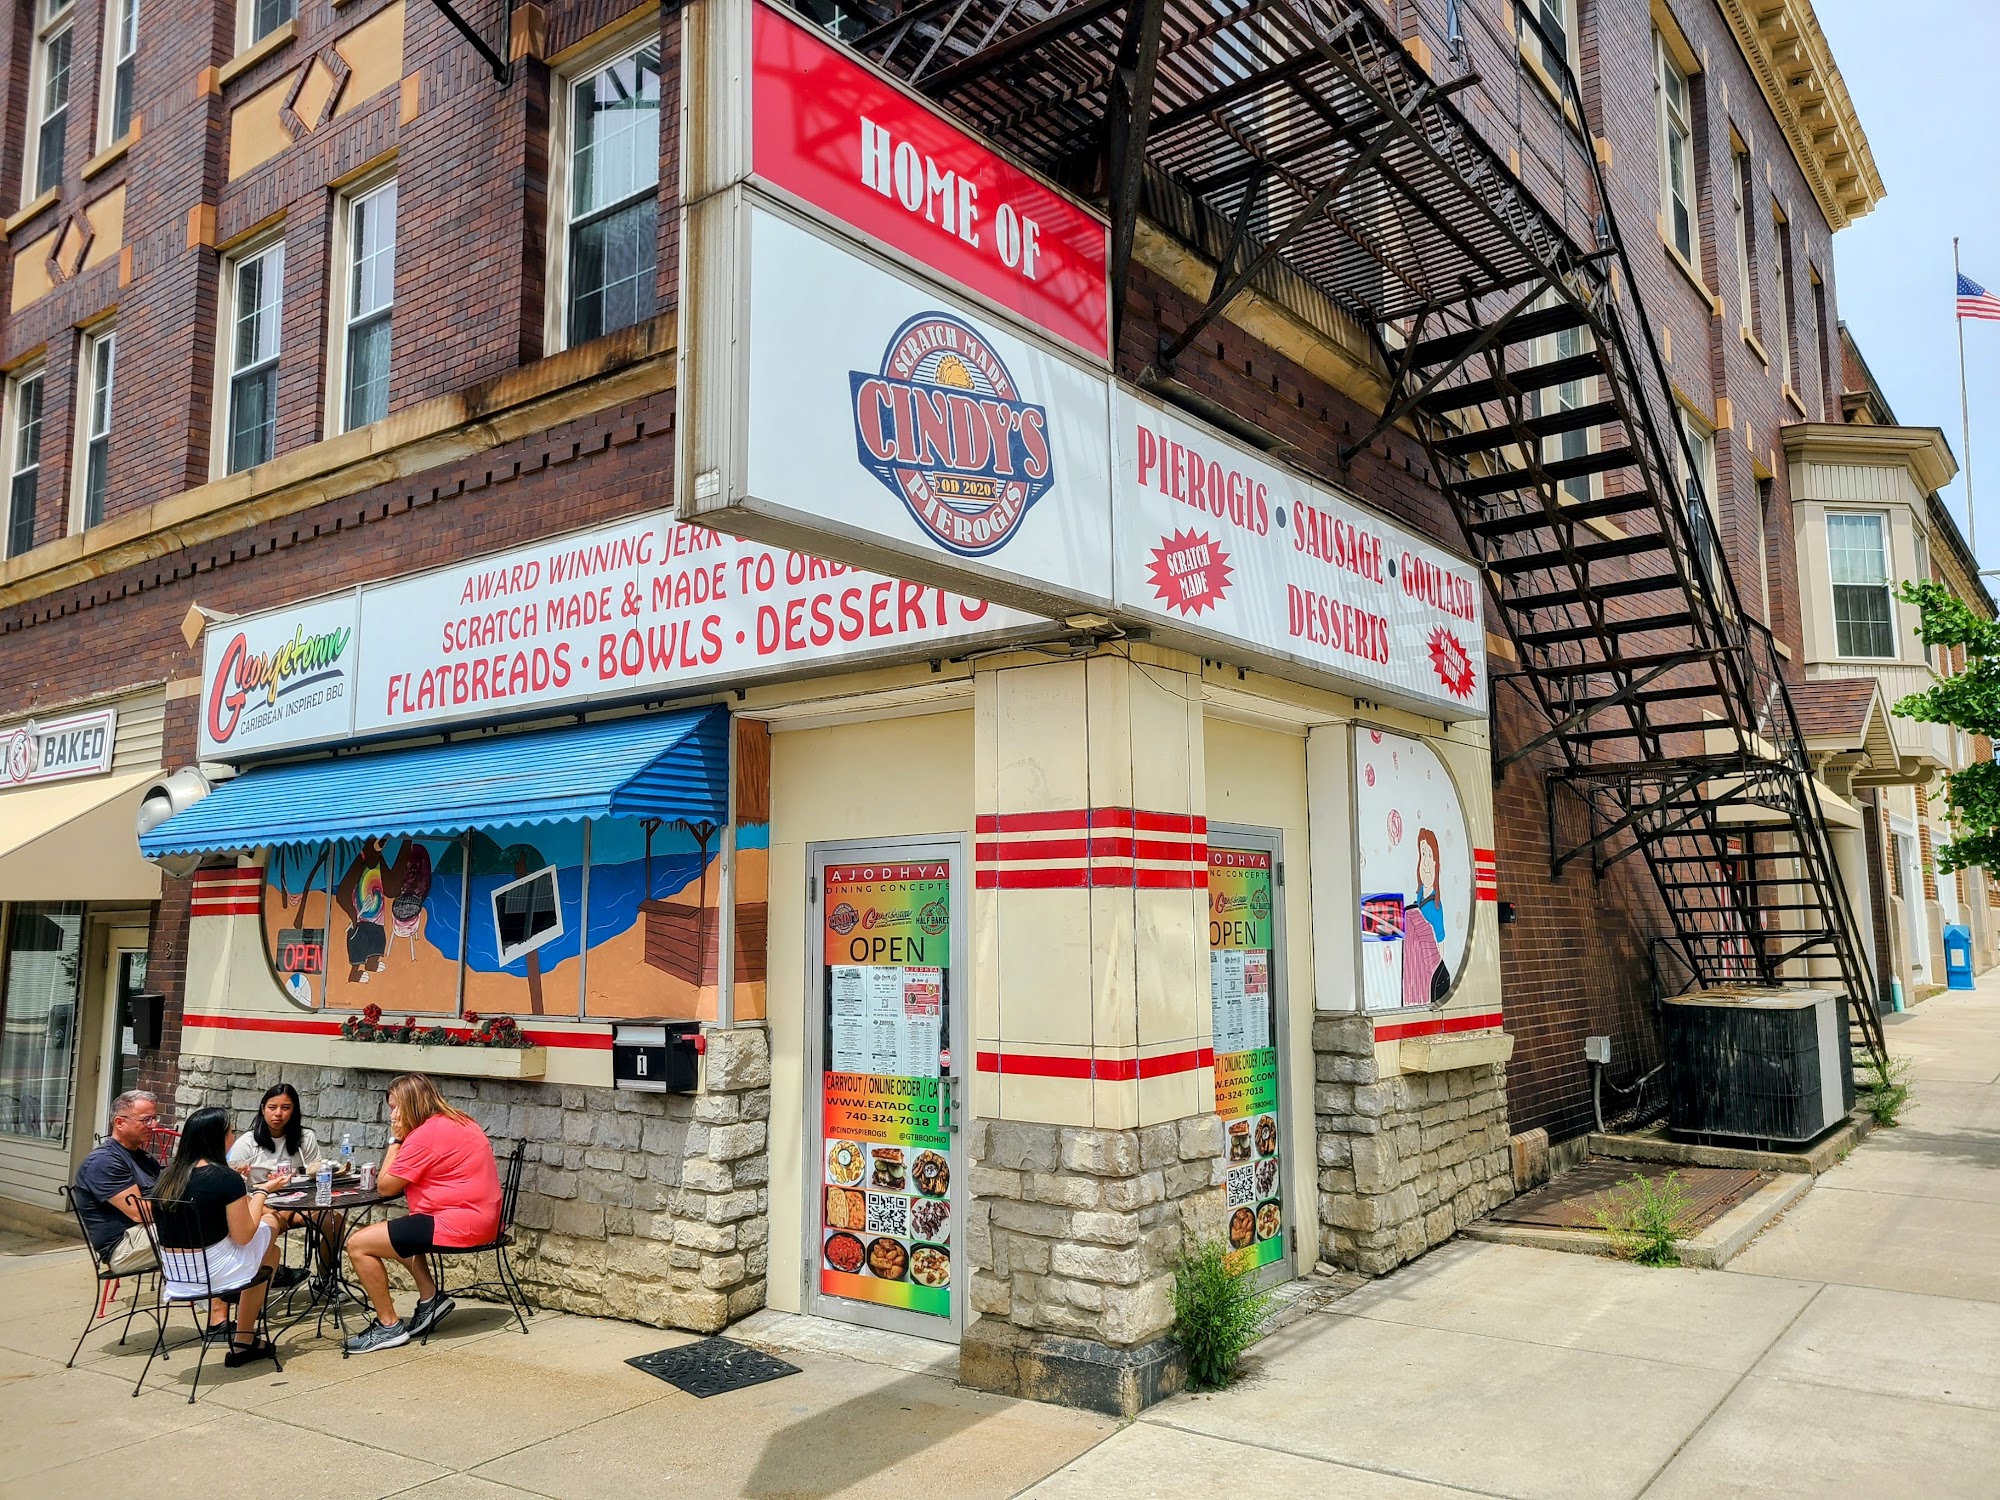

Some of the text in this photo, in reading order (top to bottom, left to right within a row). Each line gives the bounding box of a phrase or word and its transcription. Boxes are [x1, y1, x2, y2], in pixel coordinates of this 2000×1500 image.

[860, 115, 1040, 280] HOME OF
[894, 325, 1009, 396] SCRATCH MADE
[857, 378, 1049, 479] CINDY'S
[941, 479, 992, 496] OD 2020
[906, 472, 1021, 543] PIEROGIS
[1137, 424, 1475, 623] PIEROGIS SAUSAGE GOULASH
[460, 522, 723, 605] AWARD WINNING JERK
[1166, 543, 1211, 577] SCRATCH
[1179, 571, 1209, 600] MADE
[442, 603, 538, 654] SCRATCH
[547, 586, 613, 633] MADE
[620, 581, 642, 618] &
[652, 562, 727, 612] MADE
[736, 552, 775, 595] TO
[1287, 583, 1389, 666] DESSERTS
[387, 642, 571, 715] FLATBREADS
[598, 614, 723, 681] BOWLS
[1440, 634, 1466, 676] SCRATCH
[1443, 655, 1460, 687] MADE
[208, 623, 352, 744] Georgetown
[240, 682, 344, 735] CARIBBEAN INSPIRED BBQ
[44, 727, 105, 768] BAKED
[826, 882, 949, 895] DINING CONCEPTS
[831, 865, 946, 881] AJODHYA
[1226, 870, 1270, 879] CONCEPTS
[1209, 921, 1256, 946] OPEN
[1363, 901, 1404, 935] OPEN
[165, 941, 172, 958] 3
[284, 943, 323, 972] OPEN
[850, 936, 925, 962] OPEN
[639, 1056, 645, 1074] 1
[826, 1074, 863, 1093] CARRYOUT
[869, 1077, 894, 1095] ONLINE
[896, 1079, 920, 1097] ORDER
[829, 1126, 946, 1144] @CINDYSPIEROGIS @GTBBQOHIO
[845, 1111, 930, 1126] 740-324-7018
